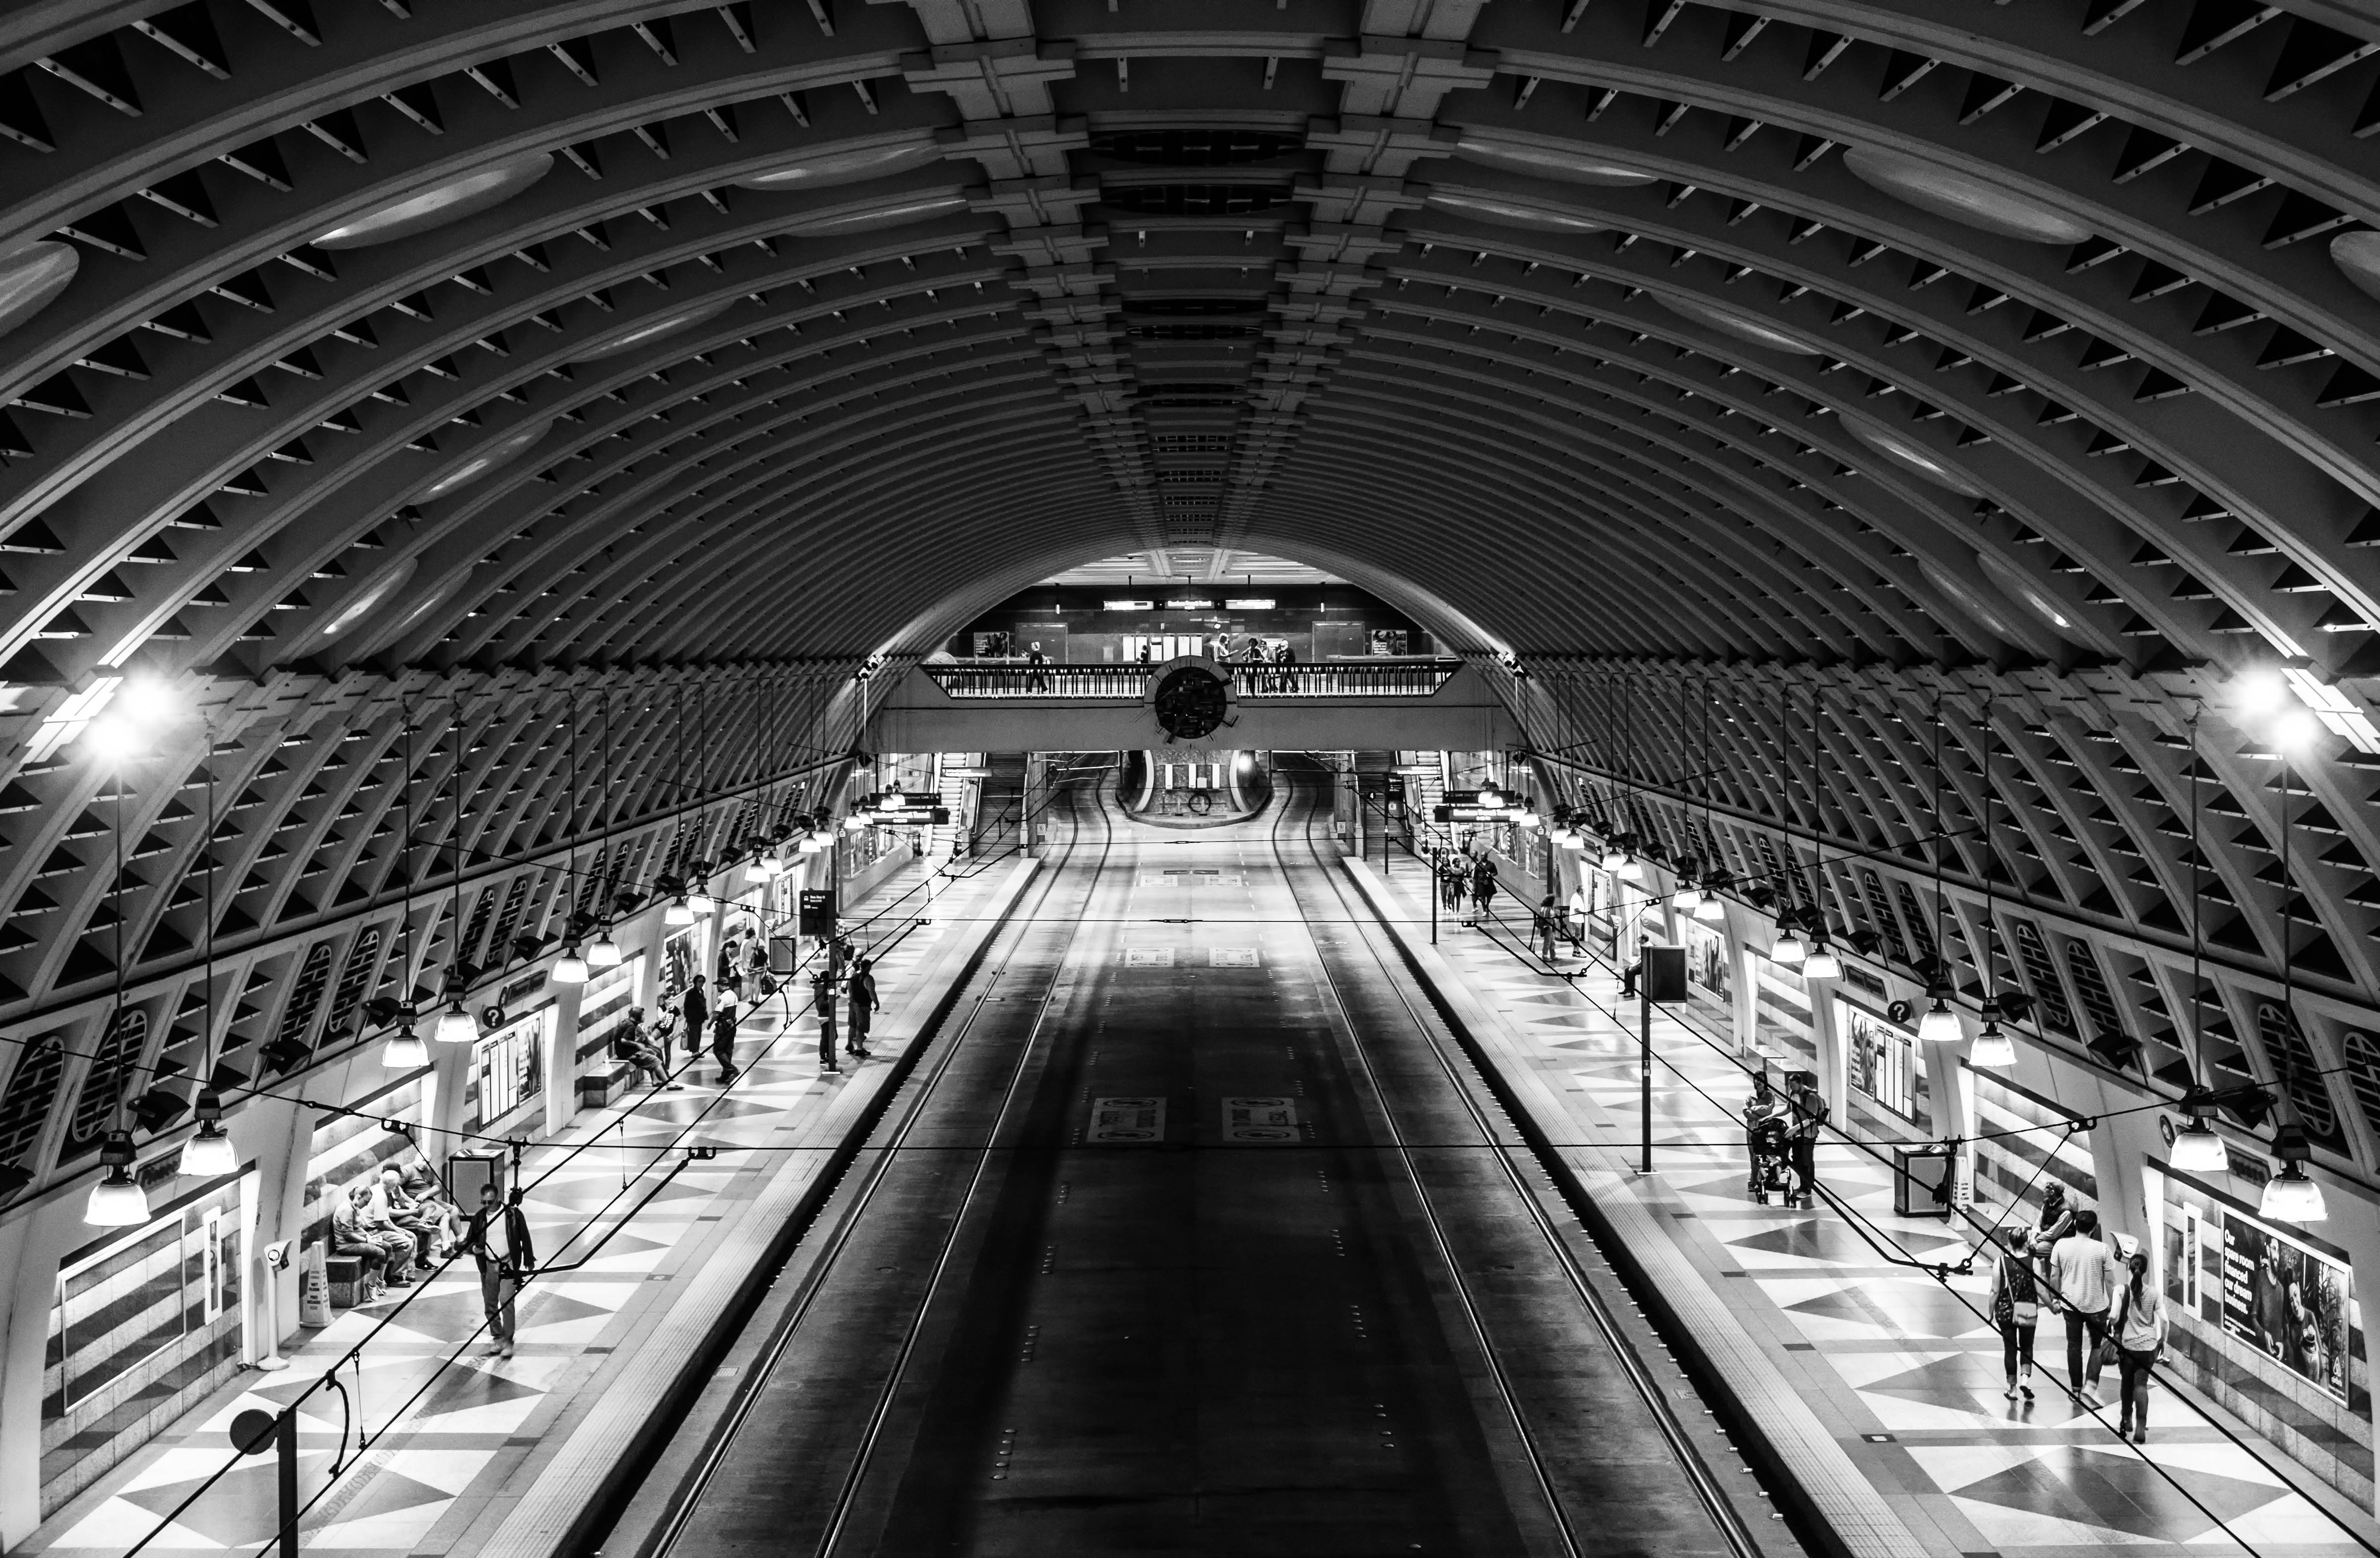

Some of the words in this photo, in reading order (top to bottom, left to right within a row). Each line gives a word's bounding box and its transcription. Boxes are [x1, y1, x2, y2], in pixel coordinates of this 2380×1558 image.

[2224, 1229, 2235, 1246] Our
[2224, 1247, 2239, 1263] spare
[2239, 1255, 2255, 1271] room
[2224, 1260, 2248, 1284] financed
[2224, 1278, 2234, 1290] our
[2234, 1280, 2252, 1302] dream
